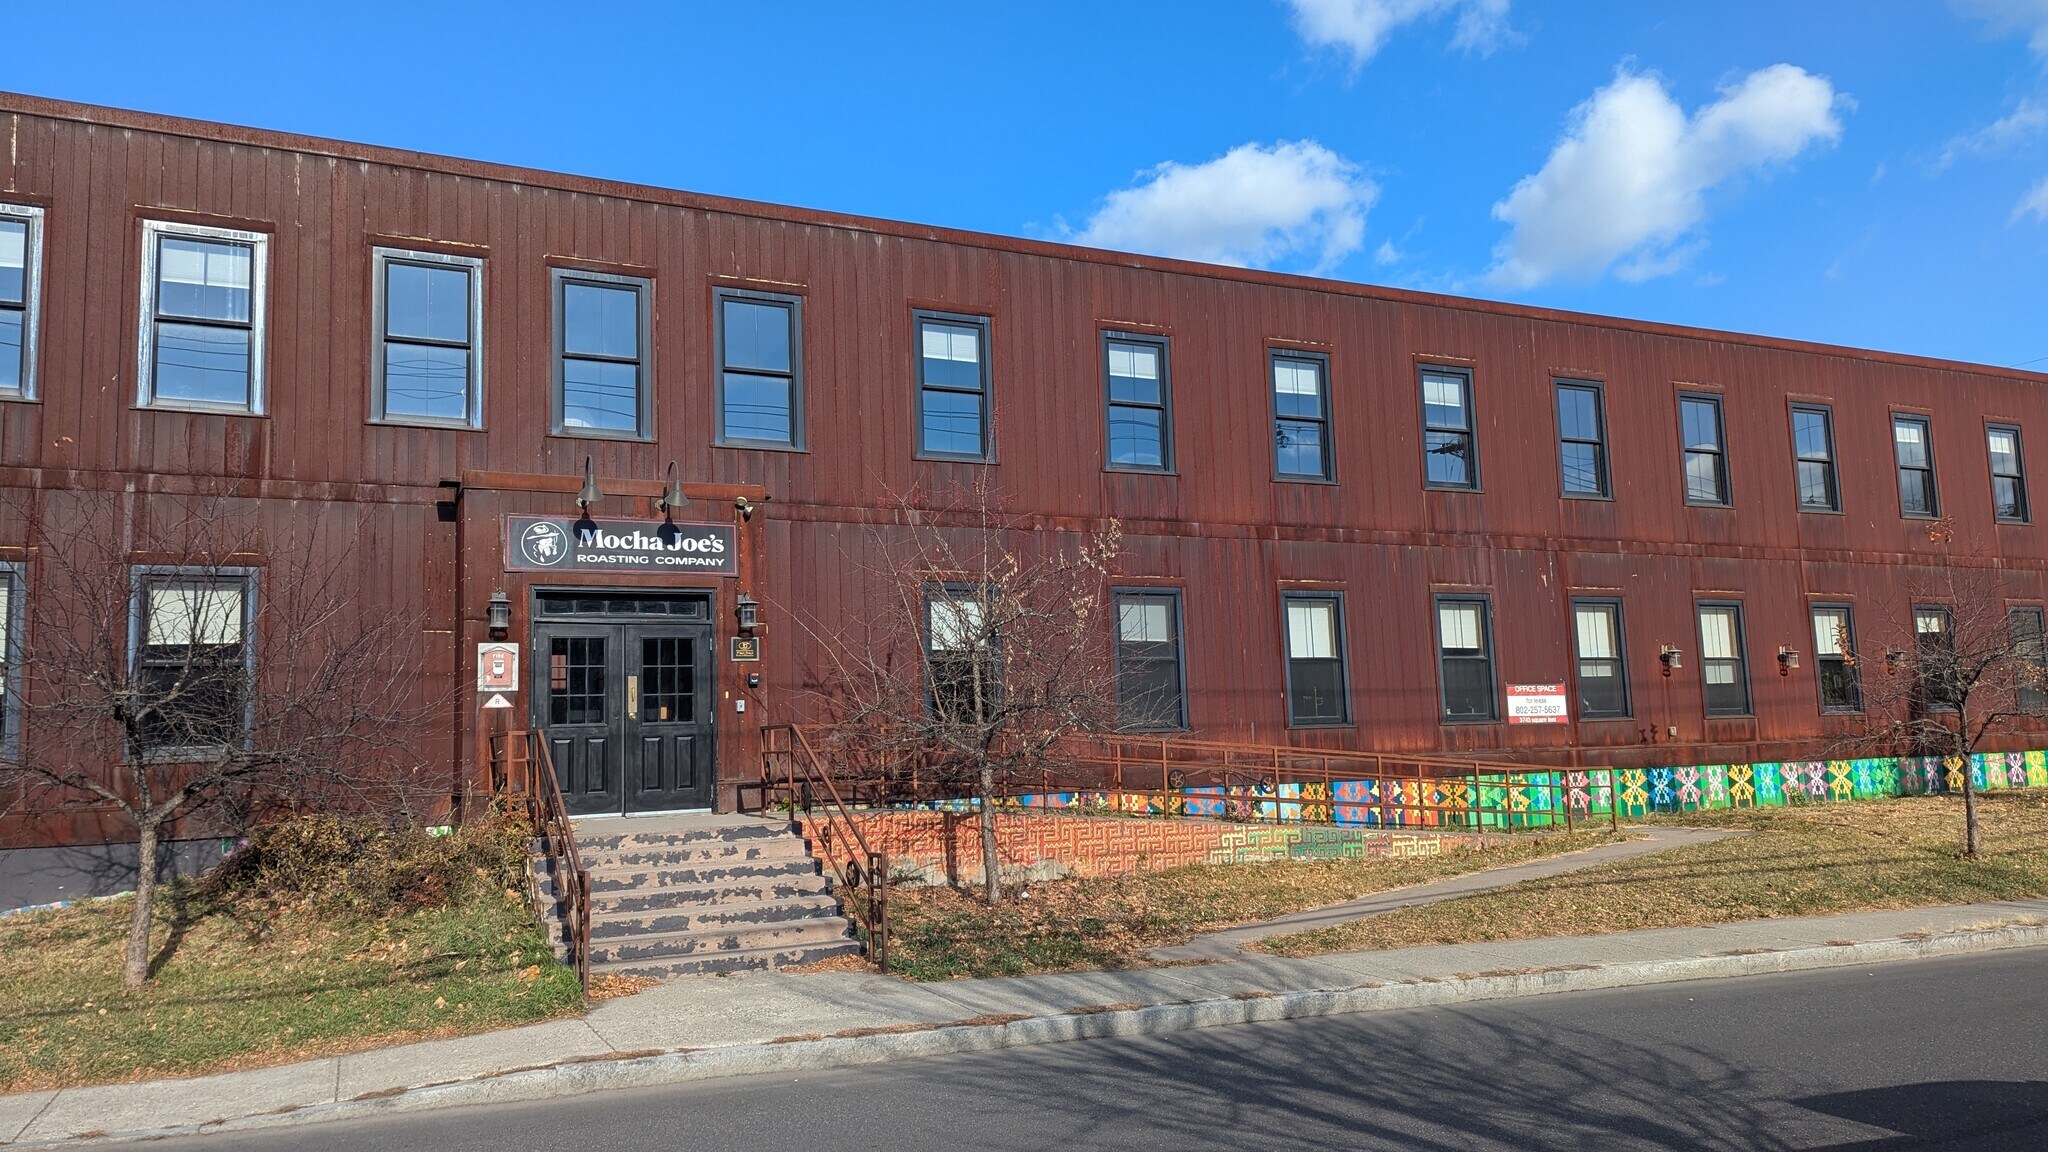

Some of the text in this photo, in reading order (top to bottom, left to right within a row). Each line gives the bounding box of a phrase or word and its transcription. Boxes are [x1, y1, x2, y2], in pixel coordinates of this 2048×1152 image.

[578, 528, 725, 553] Mocha Joe's
[577, 554, 725, 567] ROASTING COMPANY
[1516, 706, 1560, 714] 802-257-5637
